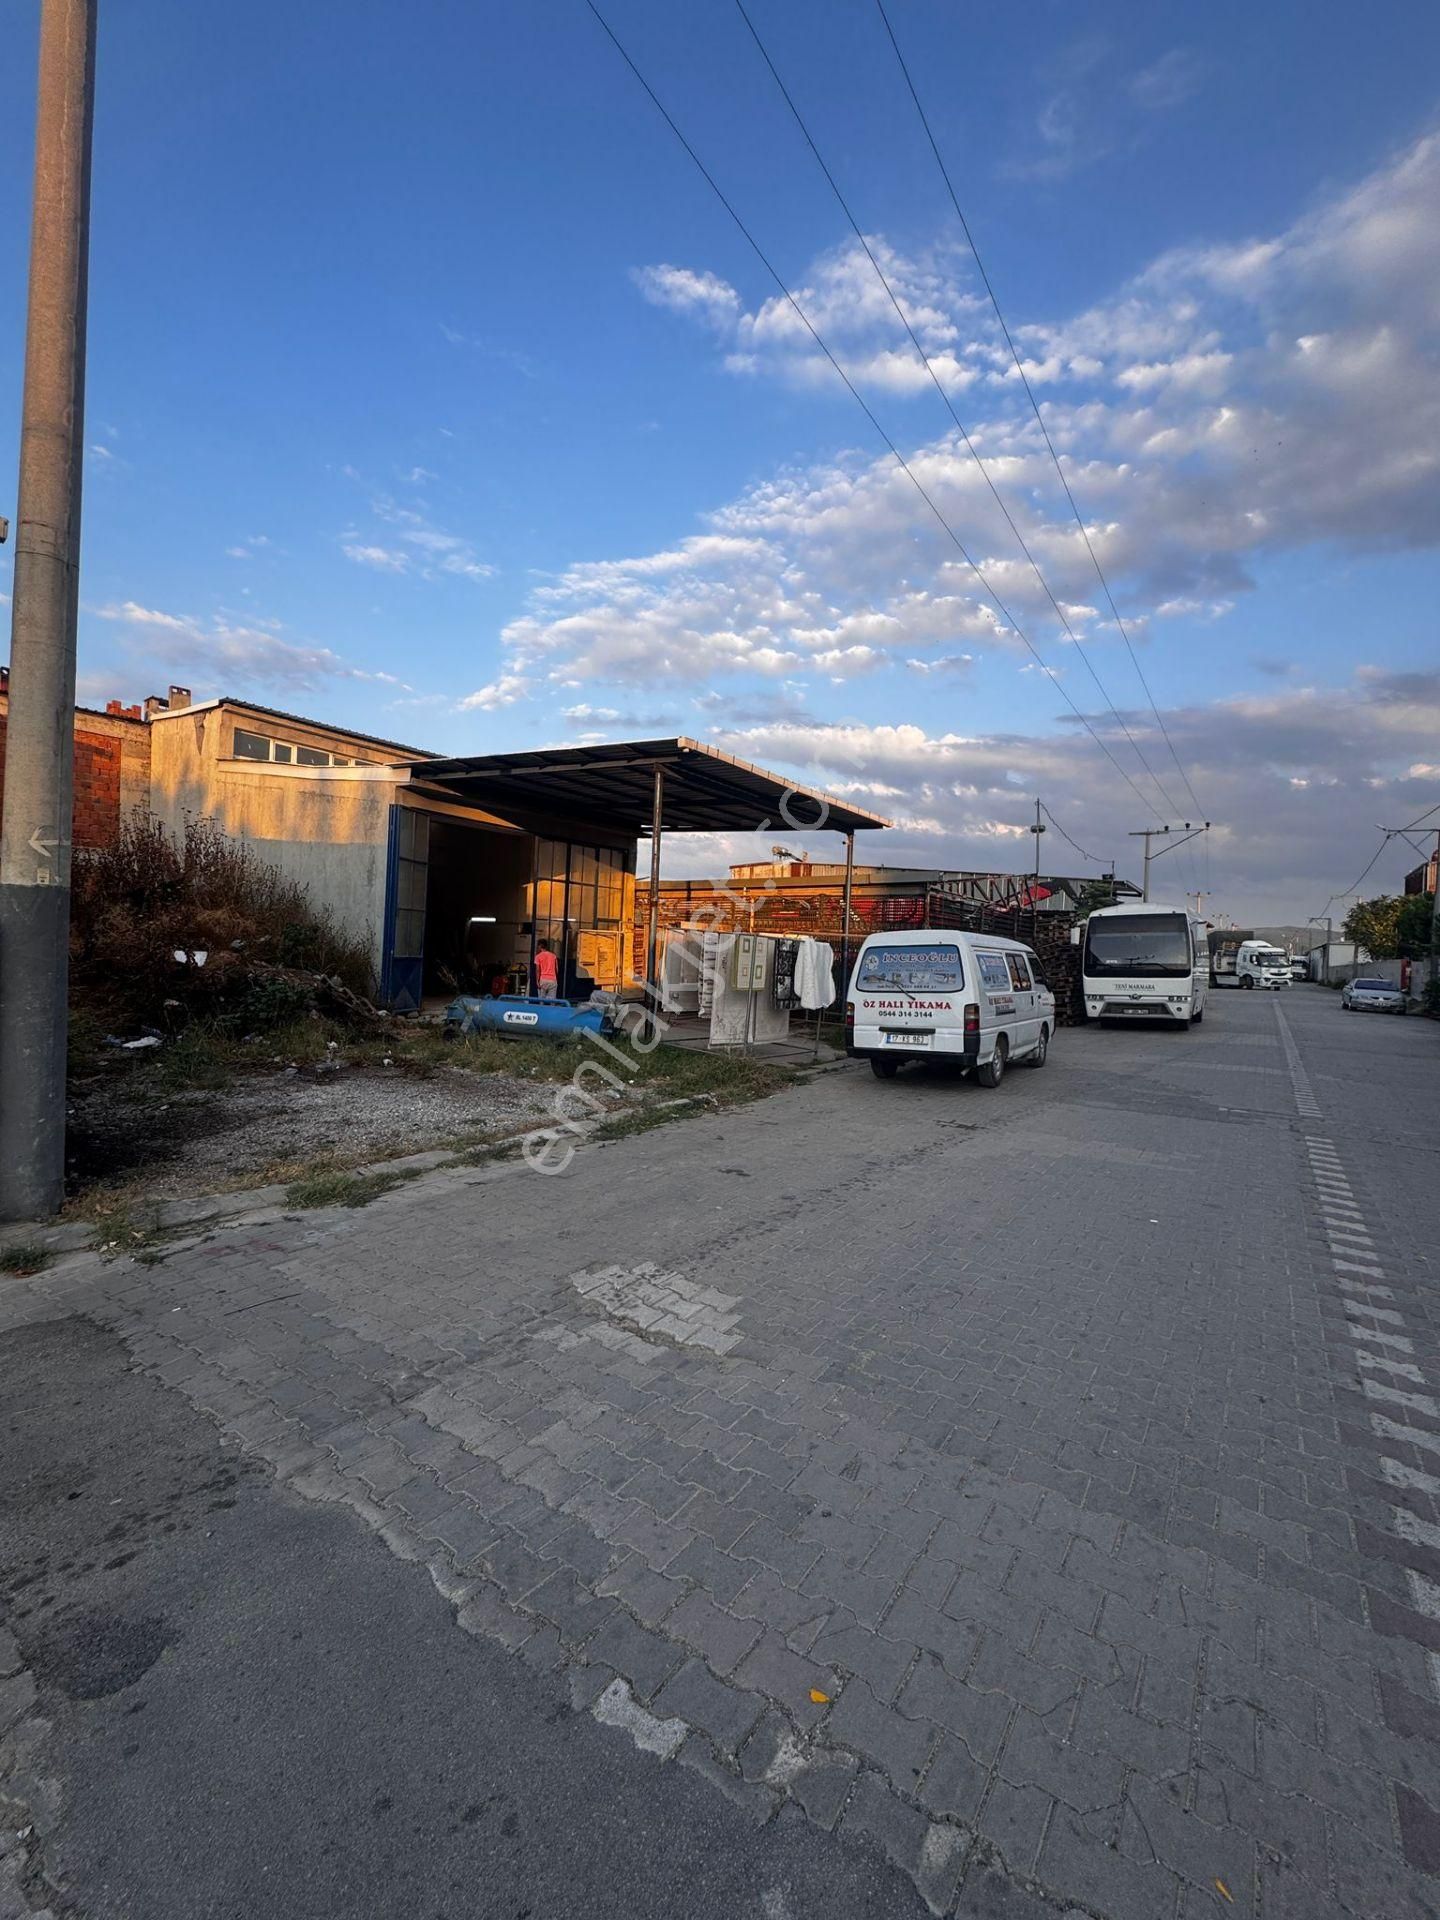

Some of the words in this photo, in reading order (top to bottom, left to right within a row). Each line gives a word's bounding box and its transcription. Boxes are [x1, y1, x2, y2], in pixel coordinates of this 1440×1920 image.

[863, 999, 875, 1008] ÖZ
[879, 1001, 904, 1009] HALI
[907, 1001, 952, 1010] YIKAMA
